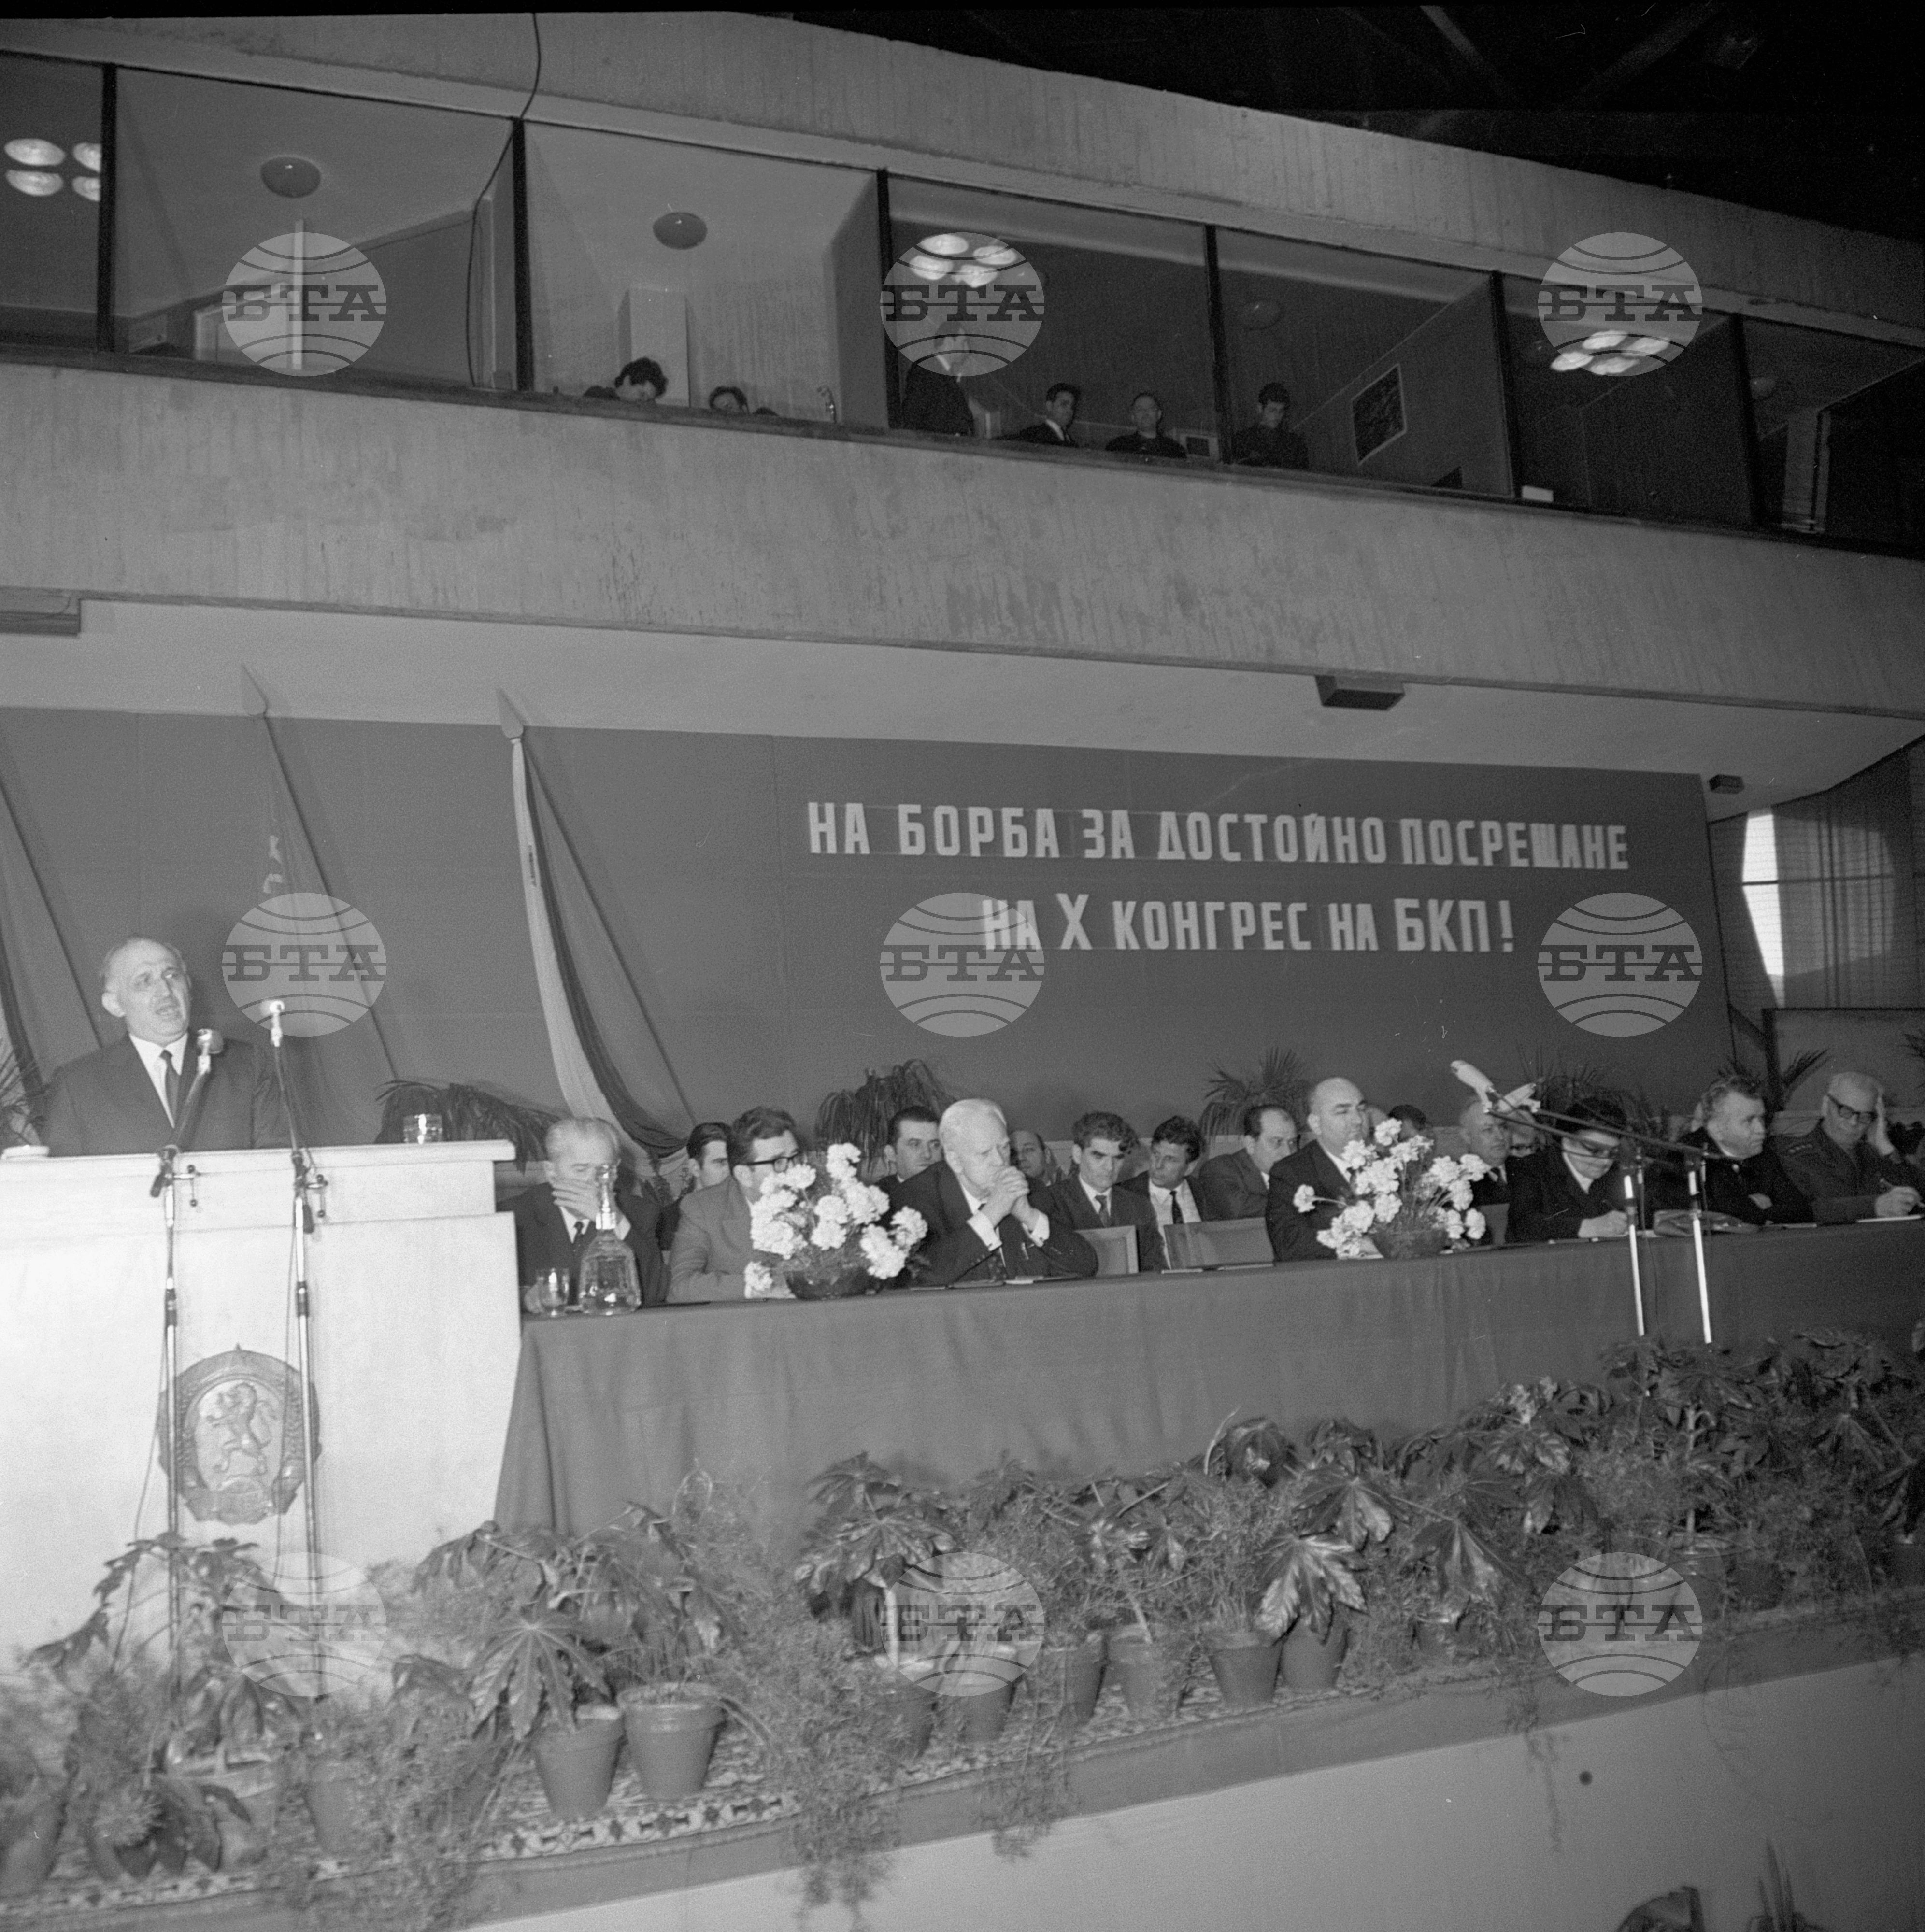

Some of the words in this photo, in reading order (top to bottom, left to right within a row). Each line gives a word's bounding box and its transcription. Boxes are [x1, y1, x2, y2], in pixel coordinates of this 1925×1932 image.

[808, 802, 870, 854] НА
[898, 804, 1060, 858] БОРБА
[1082, 809, 1135, 859] ЗА
[1157, 811, 1387, 864] ДОСТОЙНО
[982, 899, 1041, 950] НА
[1112, 900, 1312, 950] КОНГРЕС
[1328, 902, 1379, 951] НА
[1394, 898, 1514, 952] БКП!
